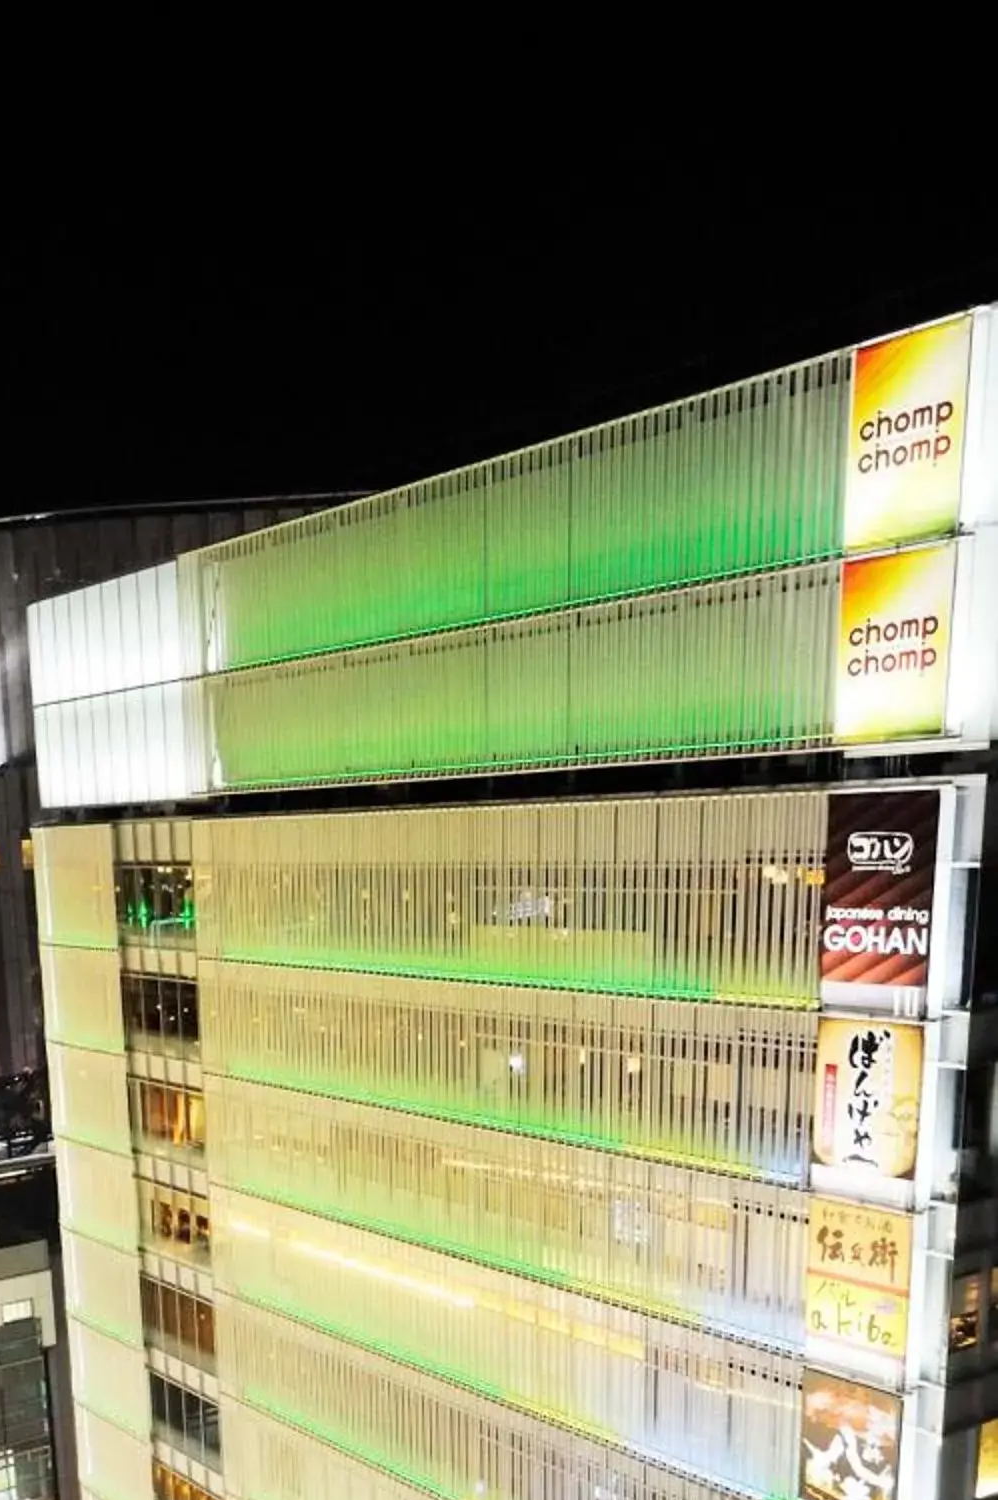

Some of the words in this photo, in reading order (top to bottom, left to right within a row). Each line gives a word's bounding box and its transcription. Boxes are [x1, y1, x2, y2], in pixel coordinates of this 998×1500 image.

[859, 400, 953, 442] chomp
[858, 434, 951, 477] chomp
[849, 614, 939, 647] chomp
[847, 646, 937, 678] chomp
[823, 923, 929, 955] GOHAN
